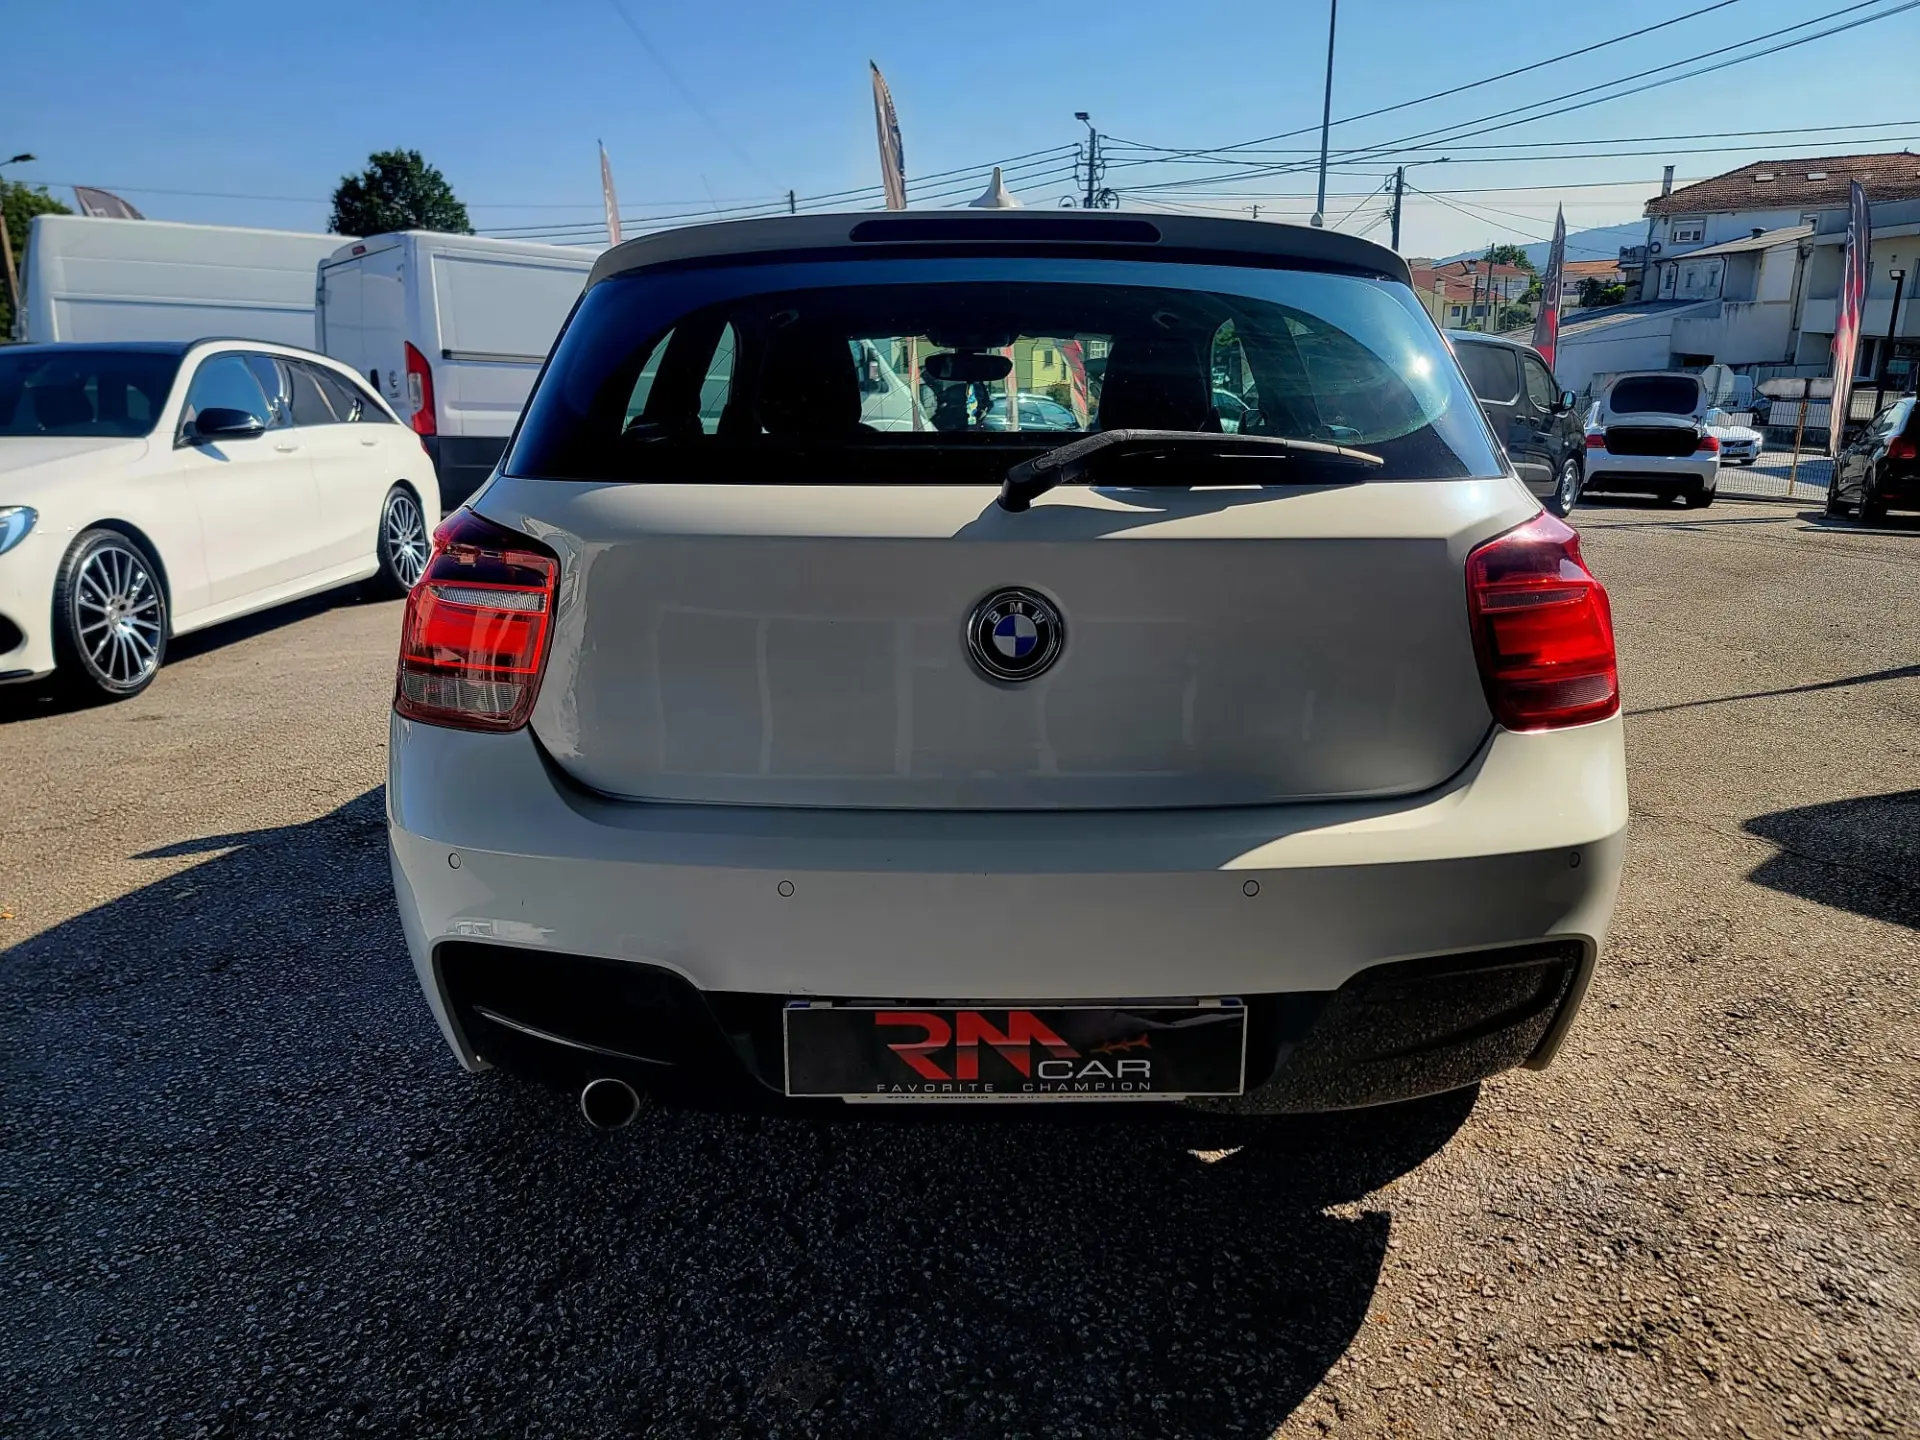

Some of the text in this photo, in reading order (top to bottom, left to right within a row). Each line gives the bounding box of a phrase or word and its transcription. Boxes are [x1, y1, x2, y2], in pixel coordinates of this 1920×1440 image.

[987, 602, 1046, 625] BMW
[1038, 1060, 1151, 1079] CAR
[876, 1082, 1151, 1092] FAVORITE CHAMPION
